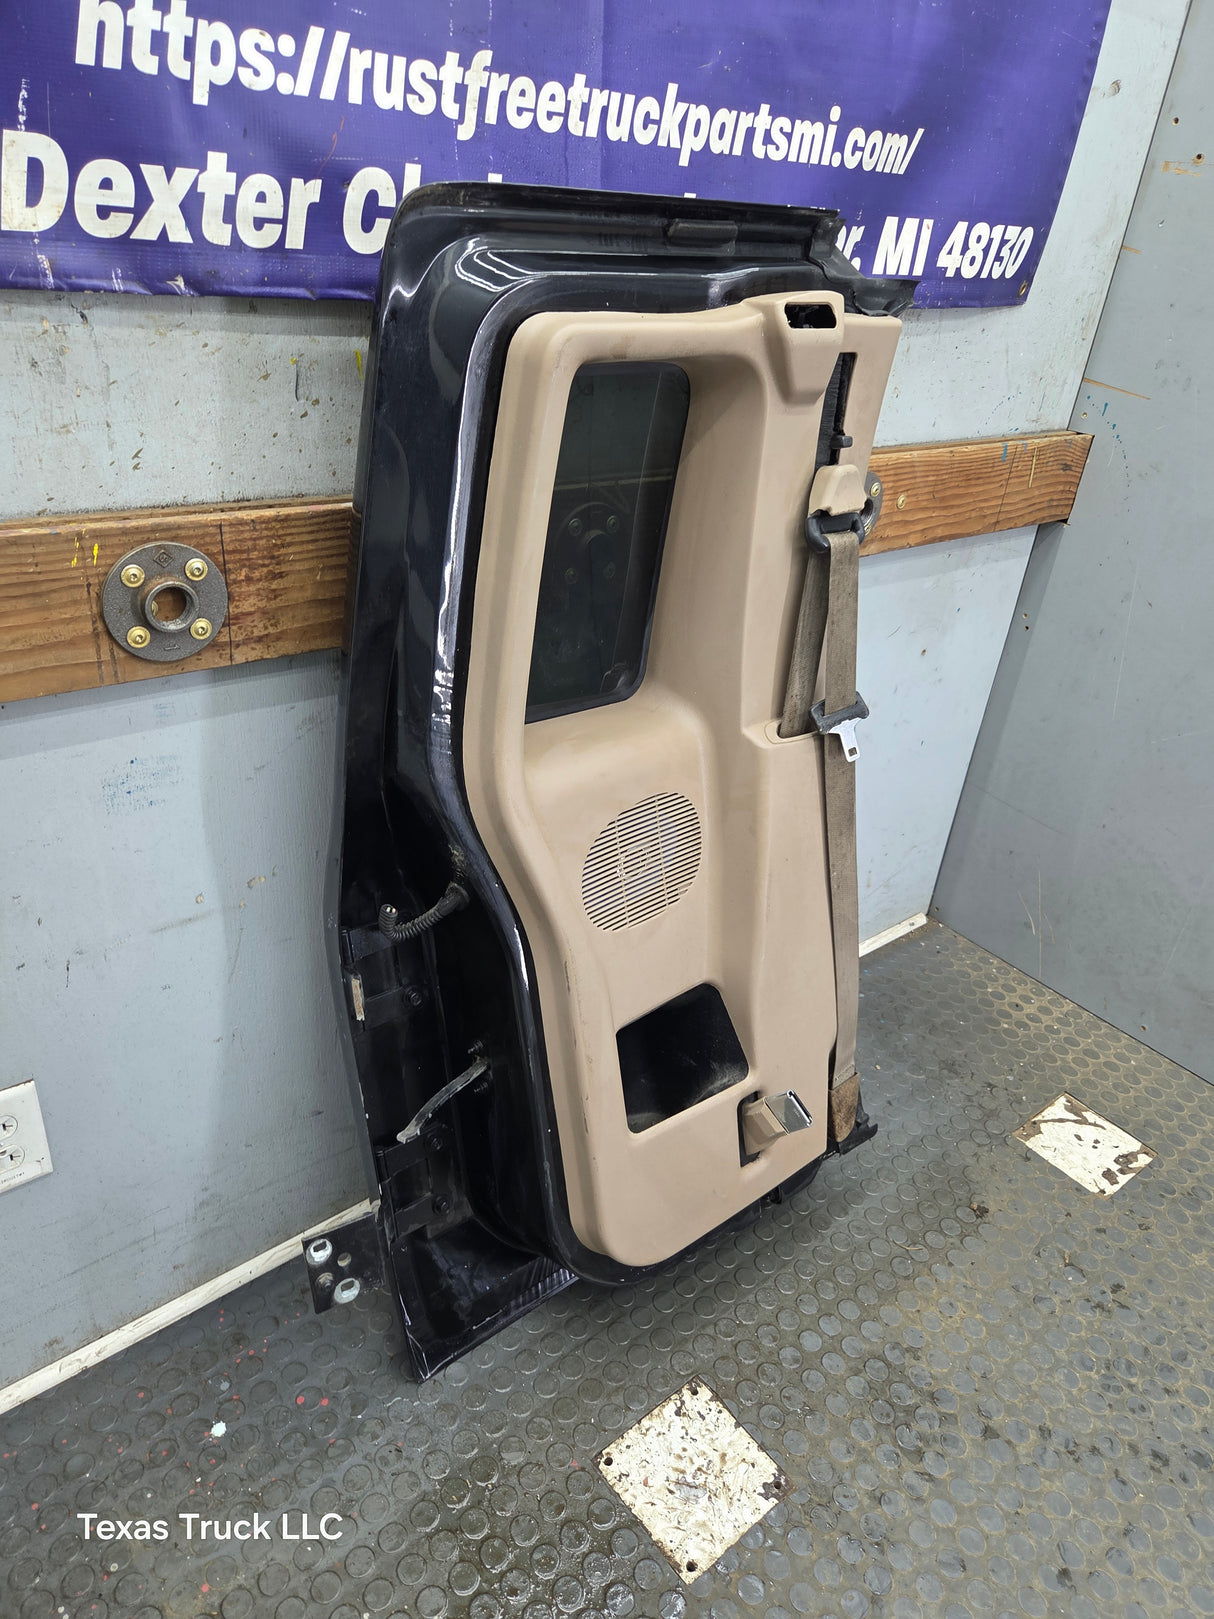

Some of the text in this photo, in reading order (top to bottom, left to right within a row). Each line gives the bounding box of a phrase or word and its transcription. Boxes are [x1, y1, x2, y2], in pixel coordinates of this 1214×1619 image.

[75, 0, 925, 175] https://rustfreetruckpartsmi.com/
[0, 129, 323, 250] Dexter
[872, 216, 935, 277] MI
[936, 220, 1035, 280] 48130
